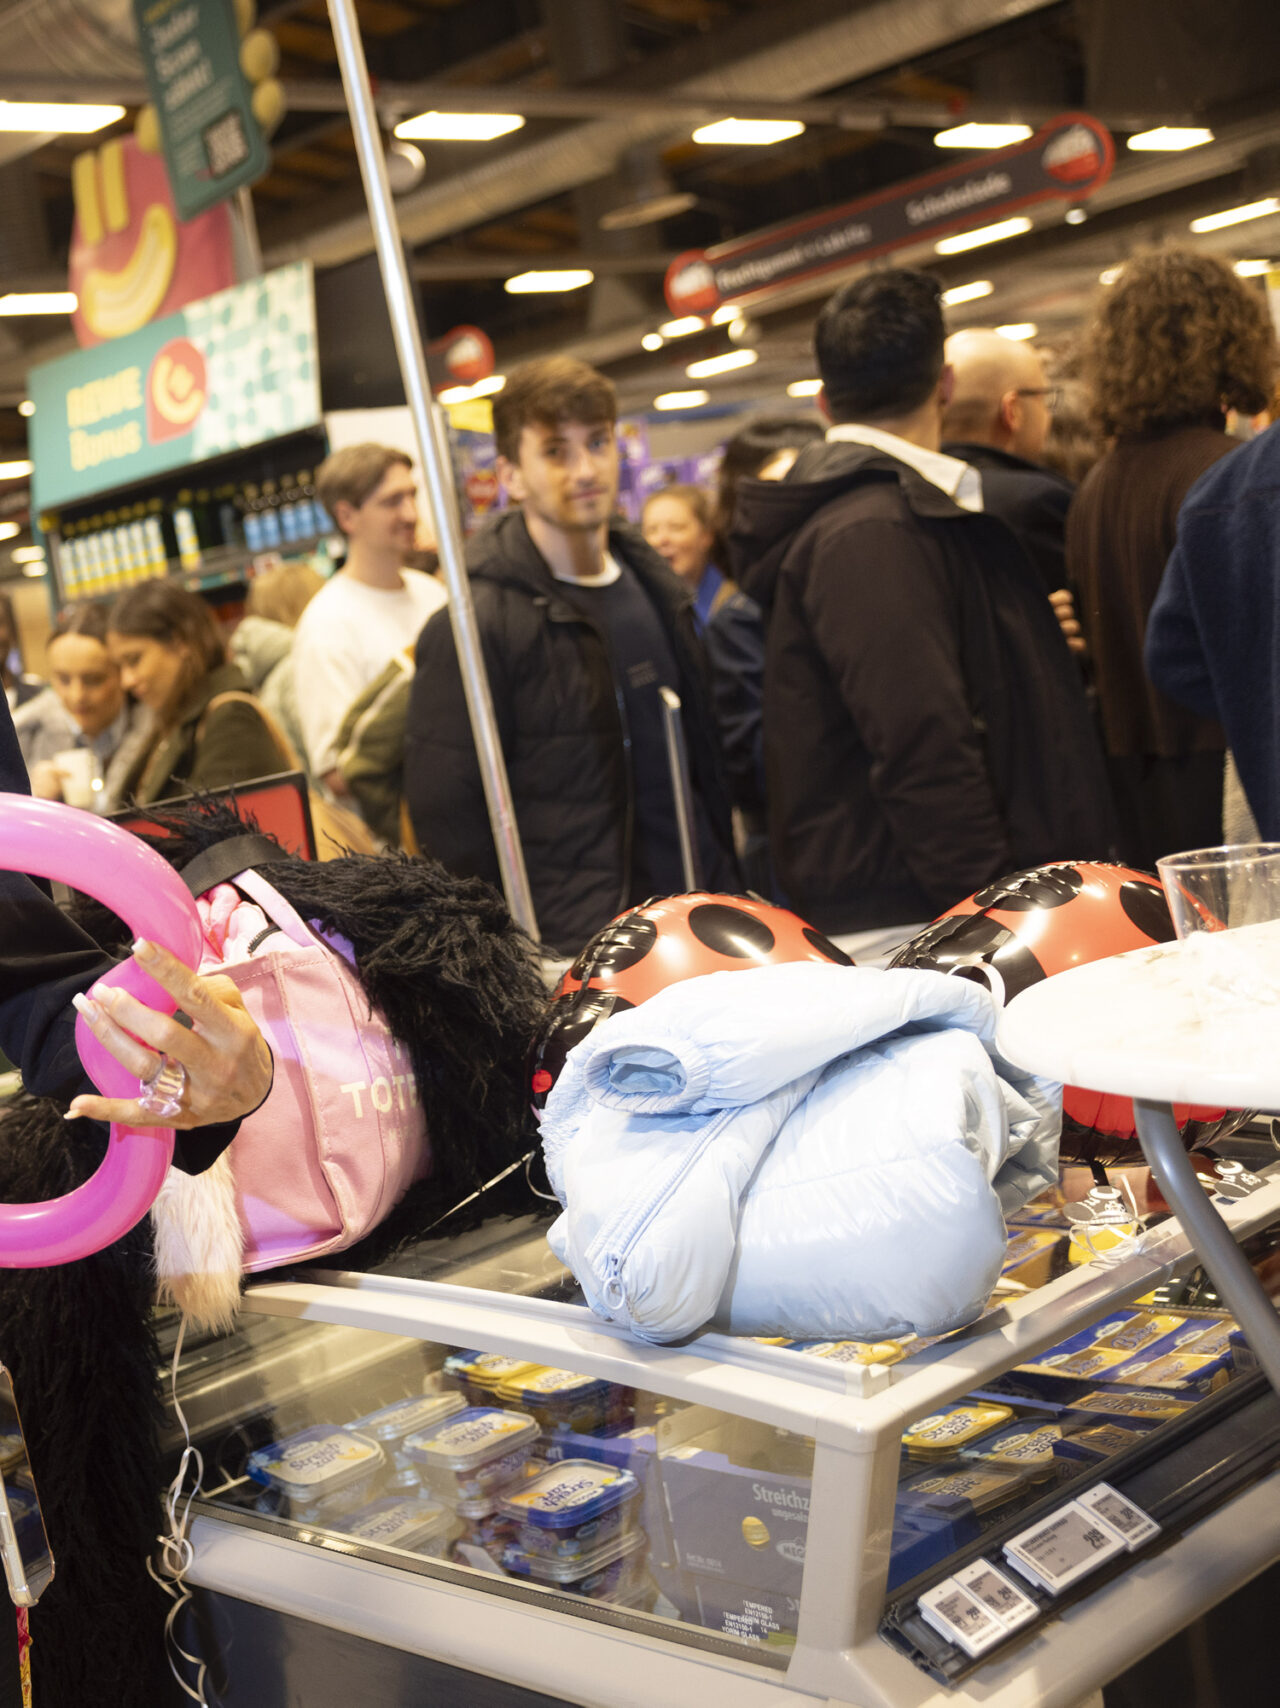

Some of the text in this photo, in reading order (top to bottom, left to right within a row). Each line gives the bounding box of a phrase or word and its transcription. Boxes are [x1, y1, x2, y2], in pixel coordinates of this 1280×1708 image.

[920, 1412, 970, 1440] Streich
[948, 1418, 977, 1436] zart
[288, 1442, 341, 1470] Streich
[1005, 1429, 1056, 1459] Streich
[1033, 1437, 1059, 1453] zart
[542, 1480, 595, 1508] Streich
